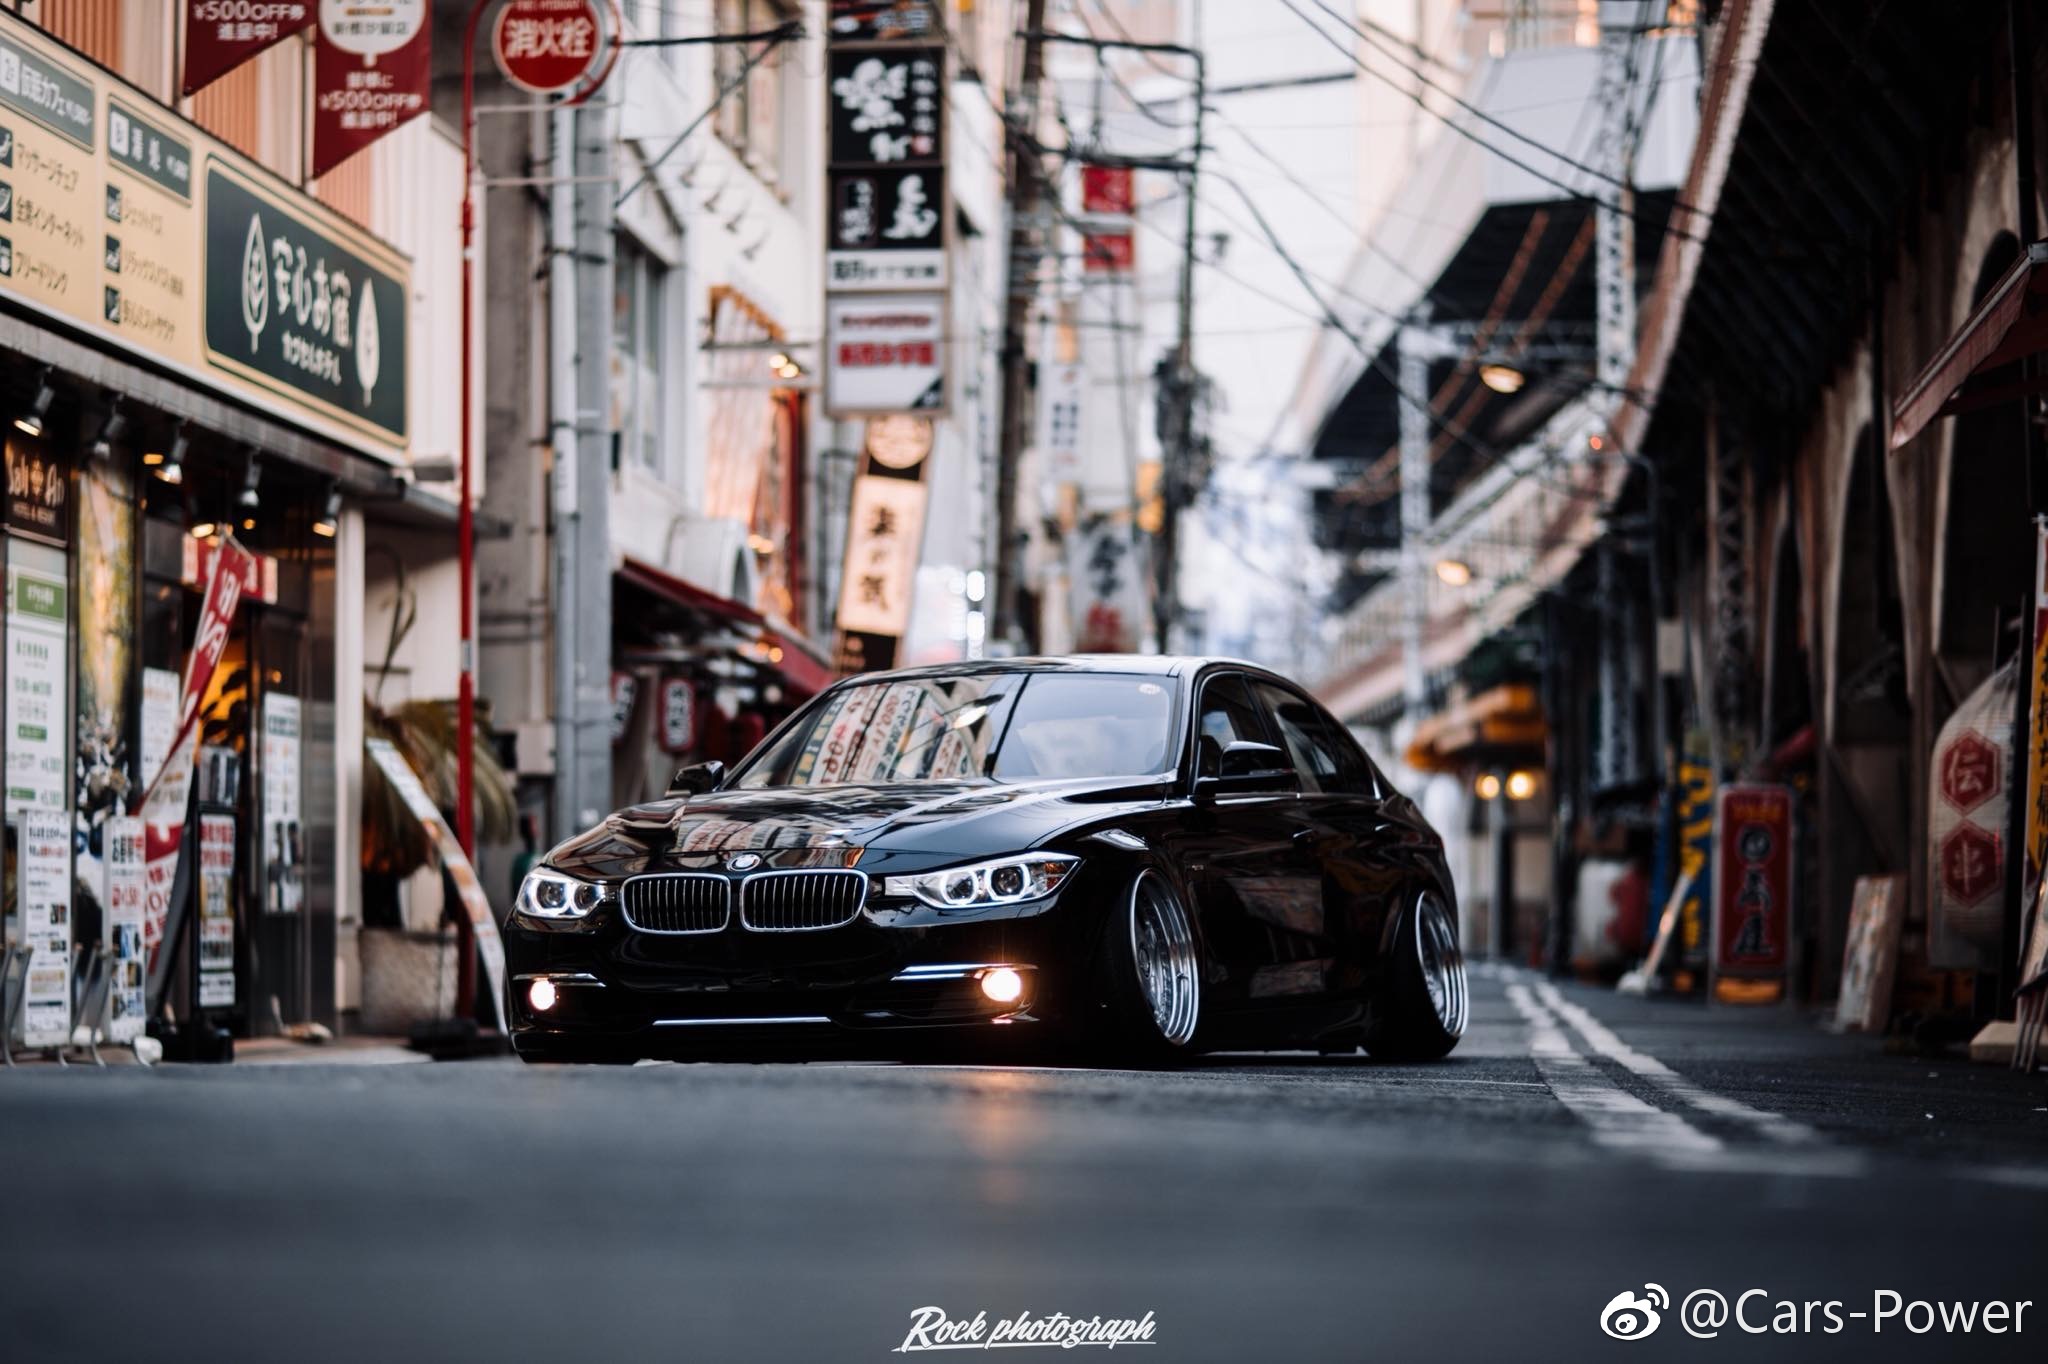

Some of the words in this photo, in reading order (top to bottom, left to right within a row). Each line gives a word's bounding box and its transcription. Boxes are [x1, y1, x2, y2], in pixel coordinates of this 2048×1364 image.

[505, 17, 594, 58] 消火栓
[272, 235, 351, 348] 安心お宿
